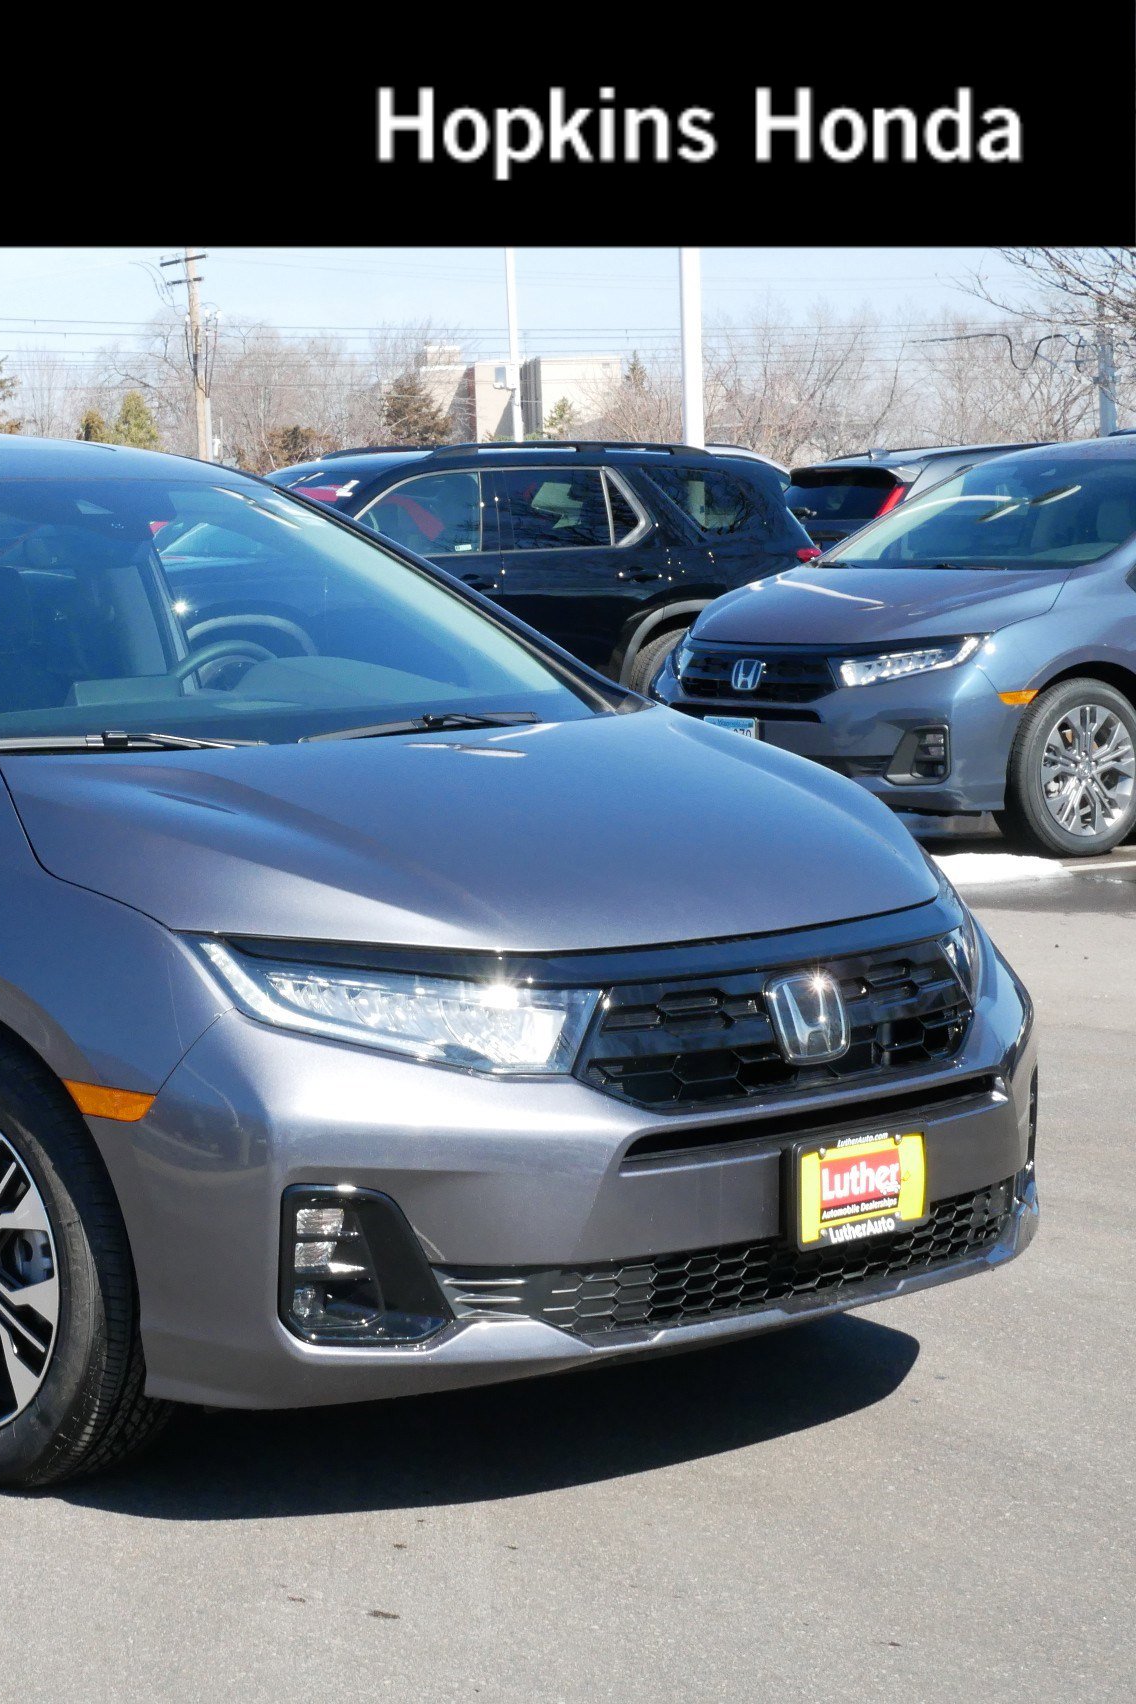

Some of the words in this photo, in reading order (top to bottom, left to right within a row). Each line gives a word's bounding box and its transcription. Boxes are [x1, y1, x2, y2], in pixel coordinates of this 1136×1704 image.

[837, 1132, 889, 1148] LutherAuto.com
[821, 1161, 900, 1201] Luther
[821, 1202, 860, 1220] Automobile
[860, 1197, 898, 1212] Dealerships
[828, 1216, 895, 1244] LutherAuto
